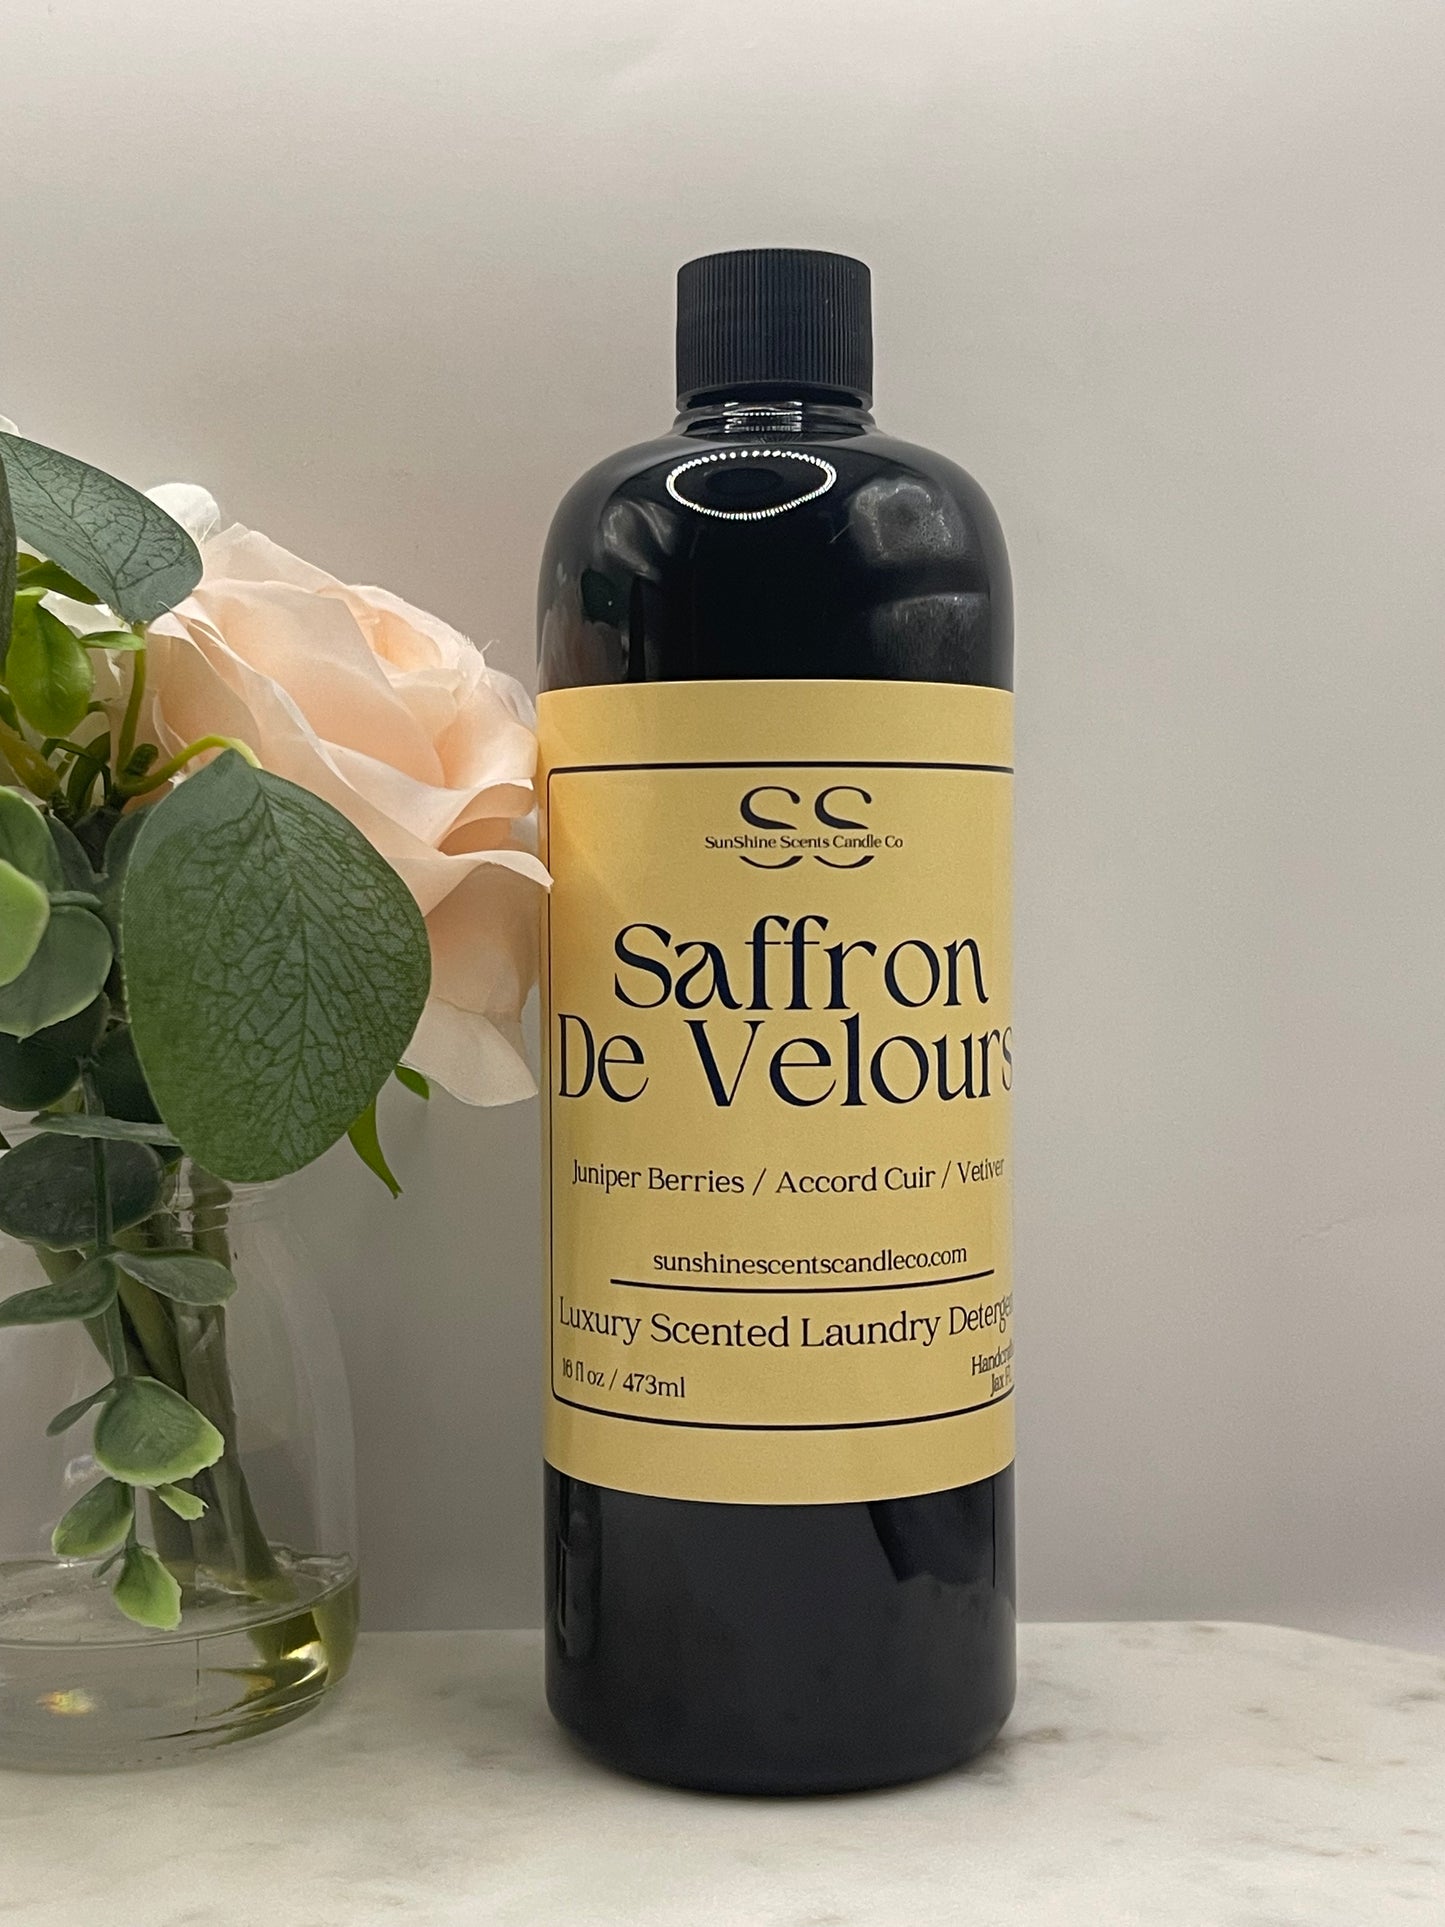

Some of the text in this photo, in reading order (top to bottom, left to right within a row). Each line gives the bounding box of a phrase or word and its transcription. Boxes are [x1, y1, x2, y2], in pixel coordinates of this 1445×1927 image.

[705, 834, 904, 849] SunShine Scents Candle Co
[614, 915, 989, 1010] Saffron
[558, 1012, 1013, 1107] De Velours
[572, 1158, 1005, 1196] Juniper Berries / Accord Cuir / Vetiver
[653, 1247, 967, 1275] sunshinescentscandleco.com
[559, 1296, 642, 1346] Luxury
[651, 1313, 789, 1348] Scented
[801, 1310, 941, 1347] Laundry
[587, 1370, 605, 1388] oz
[609, 1368, 618, 1391] /
[622, 1373, 686, 1398] 473ml
